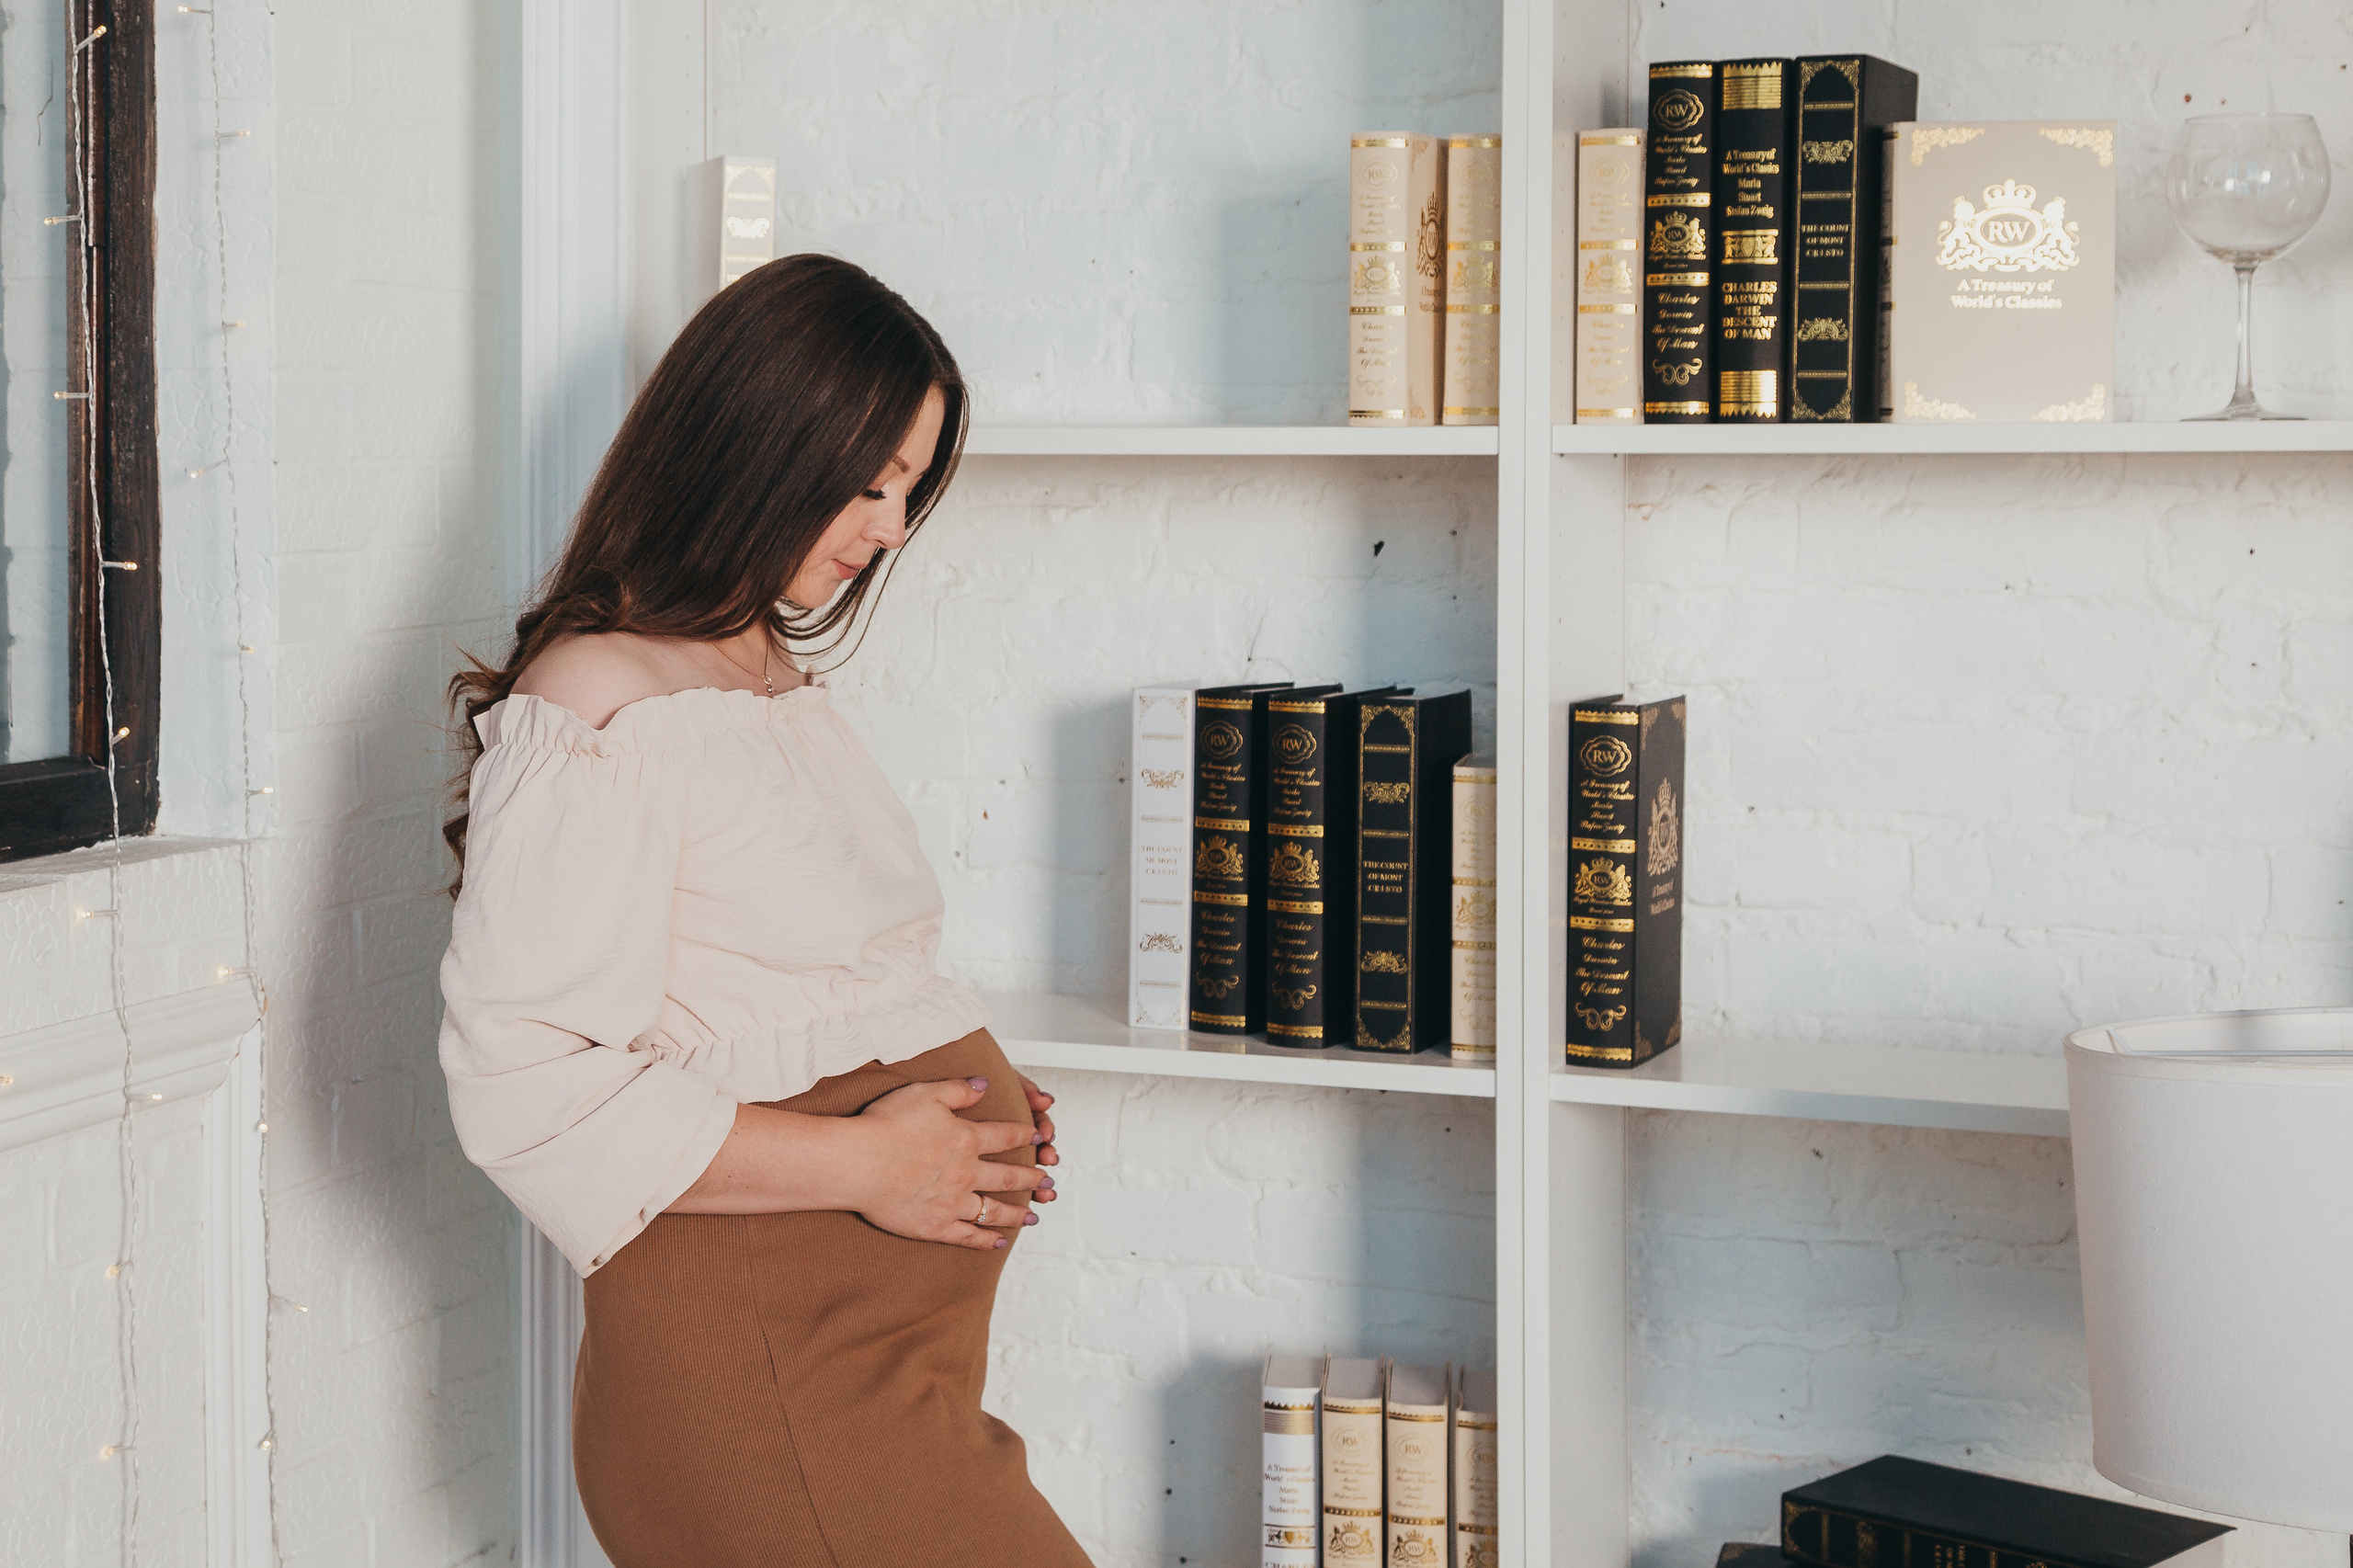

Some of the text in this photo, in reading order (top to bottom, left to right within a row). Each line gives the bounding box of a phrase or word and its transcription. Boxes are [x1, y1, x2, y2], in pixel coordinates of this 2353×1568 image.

[1666, 104, 1688, 118] RW
[1726, 148, 1777, 162] A Treasury of
[1369, 171, 1384, 179] RW
[1722, 164, 1779, 175] World's Classics
[1738, 178, 1762, 188] Maria
[1738, 192, 1762, 203] Stuart
[1726, 204, 1775, 219] Stefan Zweig
[1667, 229, 1685, 240] RW
[1802, 224, 1850, 233] THE COUNT
[1989, 222, 2030, 244] RW
[1805, 236, 1845, 245] OF MONT
[1722, 281, 1778, 293] CHARLES
[1957, 278, 2055, 295] A Treasury of
[1658, 293, 1700, 305] Charles
[1723, 294, 1774, 305] DARWIN
[1950, 295, 2063, 310] World's Classics
[1659, 309, 1695, 320] Darwin
[1735, 305, 1762, 316] THE
[1722, 316, 1778, 328] DESCENT
[1653, 324, 1705, 335] The Descent
[1724, 328, 1772, 340] OF MAN
[1657, 337, 1699, 353] Of Man
[1211, 735, 1230, 746] RW
[1282, 739, 1303, 751] RW
[1593, 749, 1618, 764] RW
[1589, 779, 1620, 791] Treasury
[1381, 861, 1409, 870] COUNT
[1381, 873, 1404, 881] MONT
[1594, 875, 1612, 884] RW
[1202, 911, 1237, 923] Charles
[1277, 920, 1314, 932] Charles
[1583, 937, 1626, 951] Charles
[1584, 953, 1620, 965] Darwin
[1575, 967, 1630, 981] The Descent
[1581, 981, 1623, 997] Of Man
